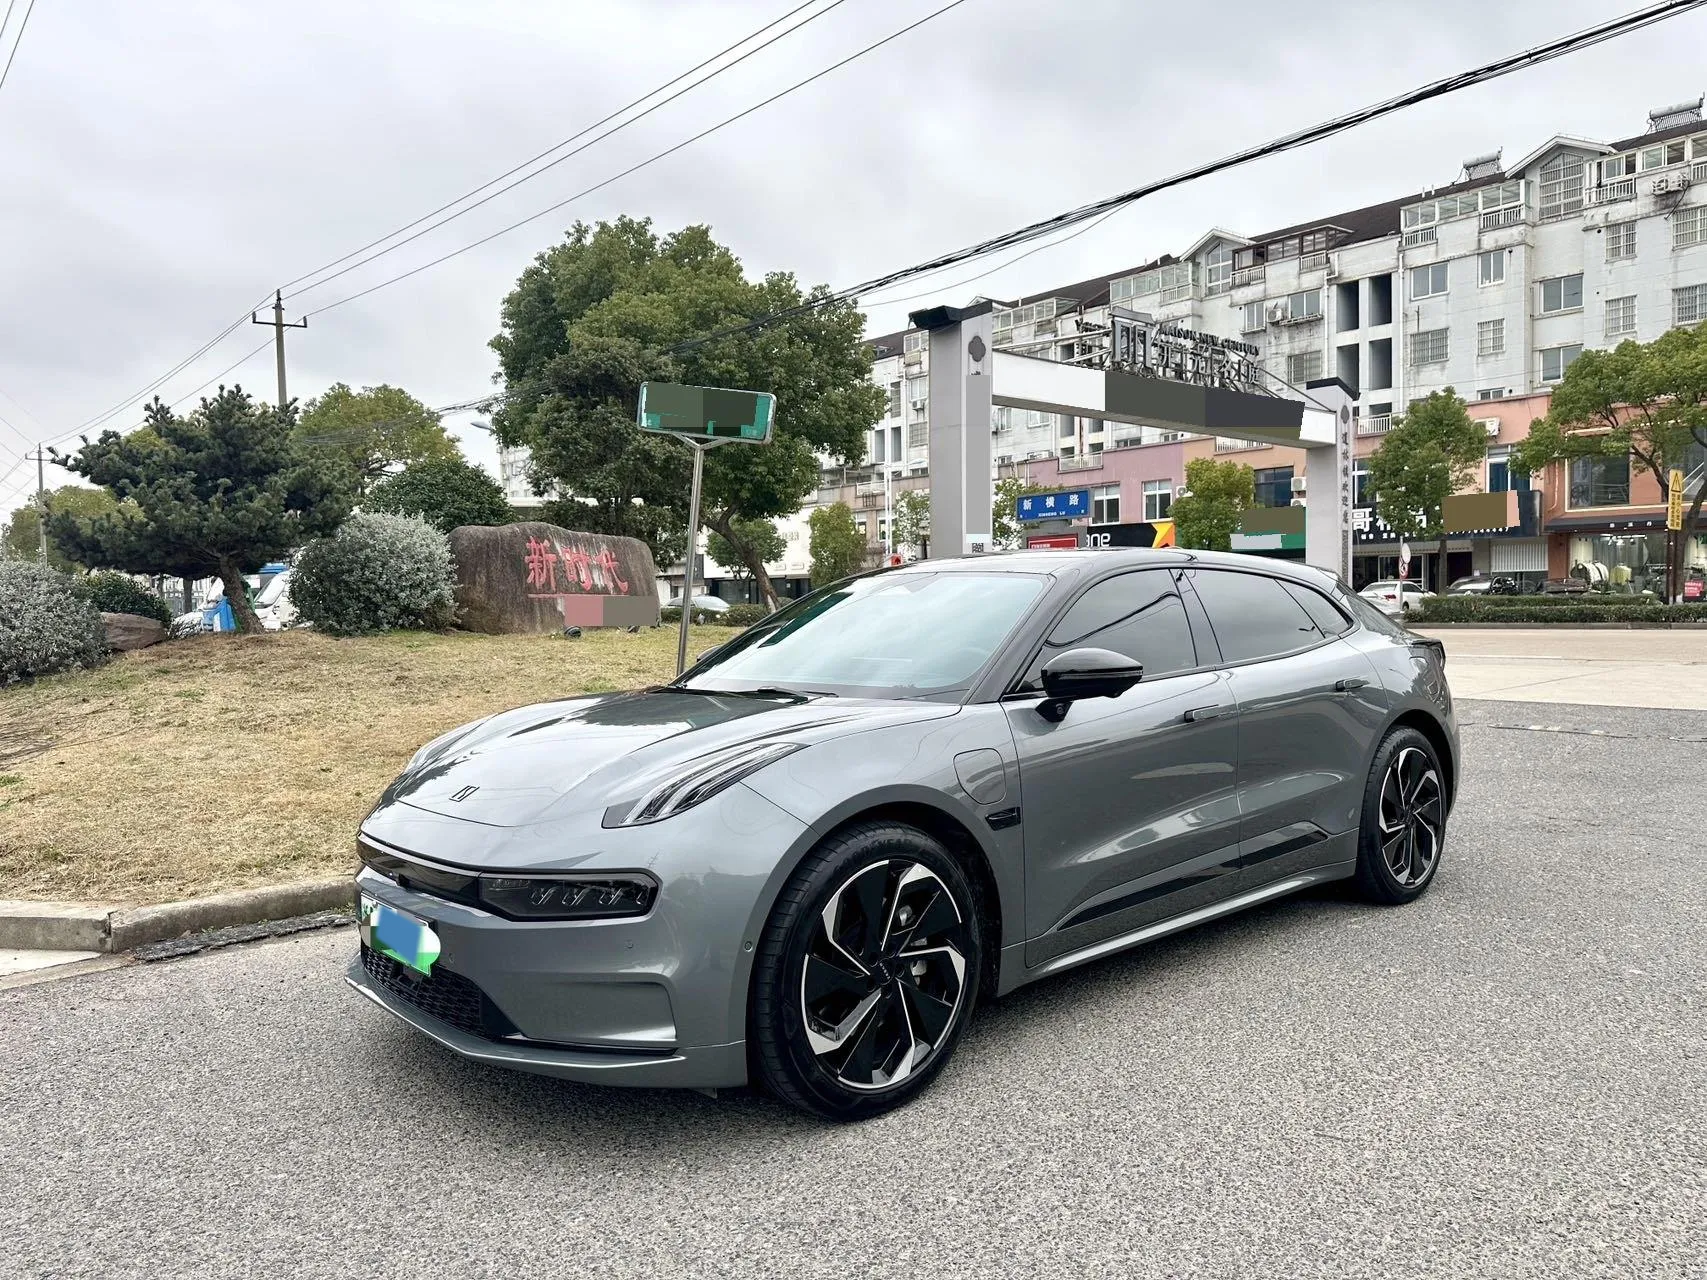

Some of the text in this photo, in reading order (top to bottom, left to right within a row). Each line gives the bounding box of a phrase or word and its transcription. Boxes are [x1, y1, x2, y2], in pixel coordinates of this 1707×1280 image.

[1159, 325, 1197, 342] MAISON
[1220, 335, 1261, 357] CENTURY
[1023, 493, 1080, 511] 新横路
[525, 535, 629, 593] 新时代
